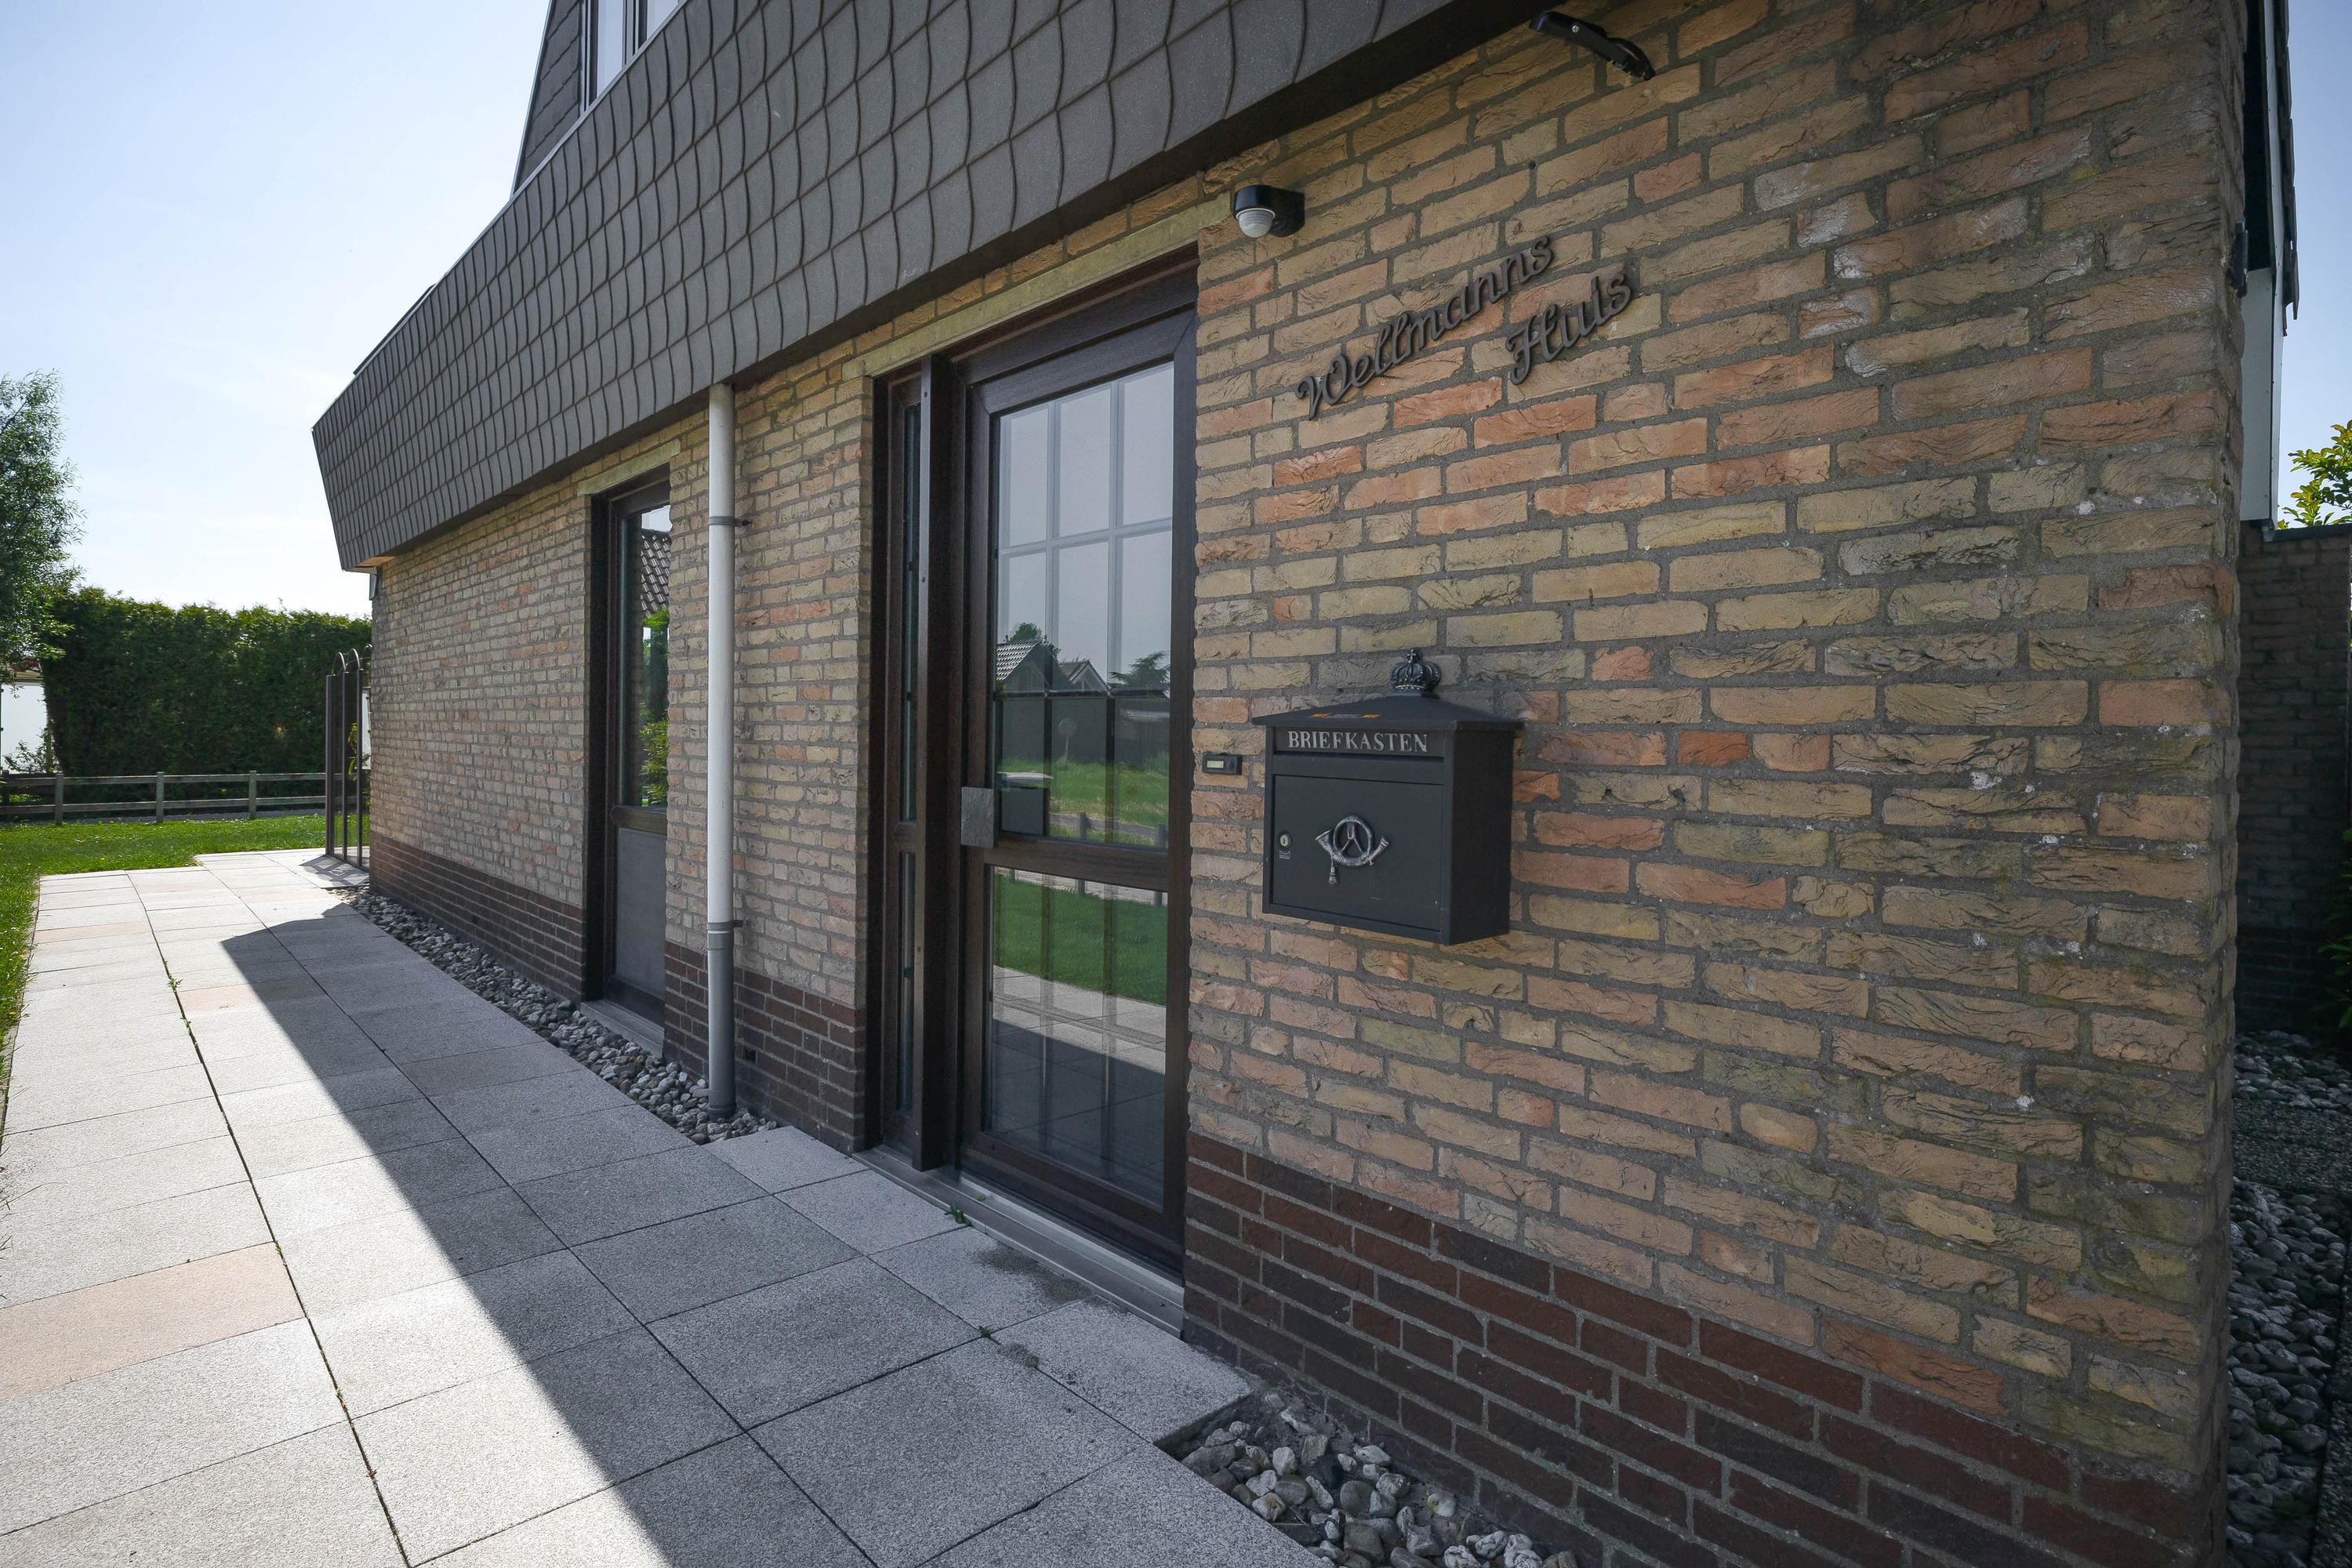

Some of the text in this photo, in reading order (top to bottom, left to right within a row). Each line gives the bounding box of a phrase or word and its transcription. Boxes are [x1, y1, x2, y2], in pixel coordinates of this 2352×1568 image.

[1296, 235, 1554, 421] Wellmanns
[1505, 274, 1632, 385] Huis
[1287, 731, 1428, 753] BRIEFKASTEN
